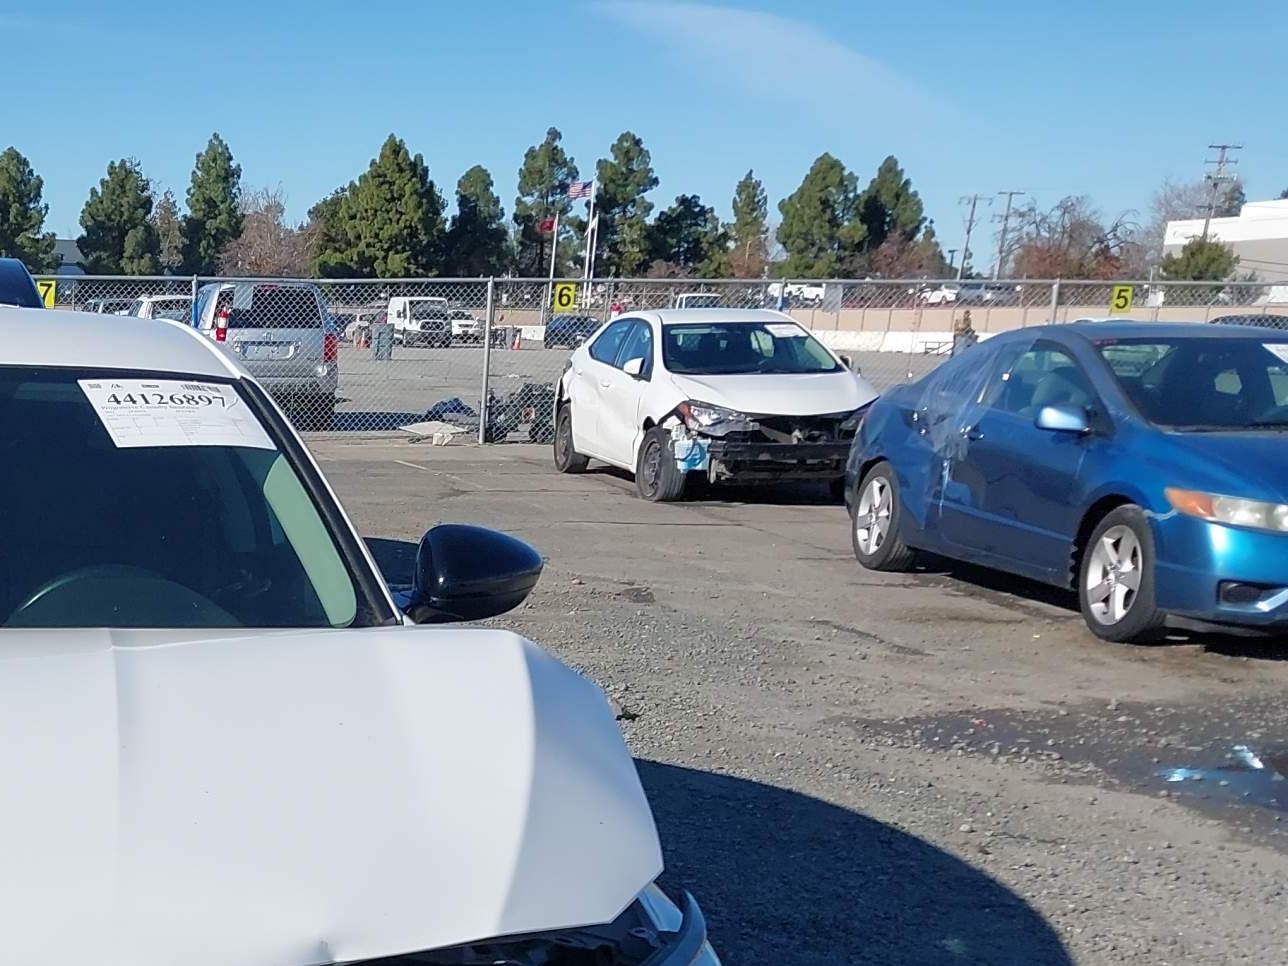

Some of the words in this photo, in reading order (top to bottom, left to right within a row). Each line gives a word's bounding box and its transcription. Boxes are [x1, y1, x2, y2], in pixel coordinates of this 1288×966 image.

[39, 282, 53, 300] 7
[558, 286, 572, 307] 6
[1115, 288, 1130, 309] 5
[107, 393, 226, 408] 44126897
